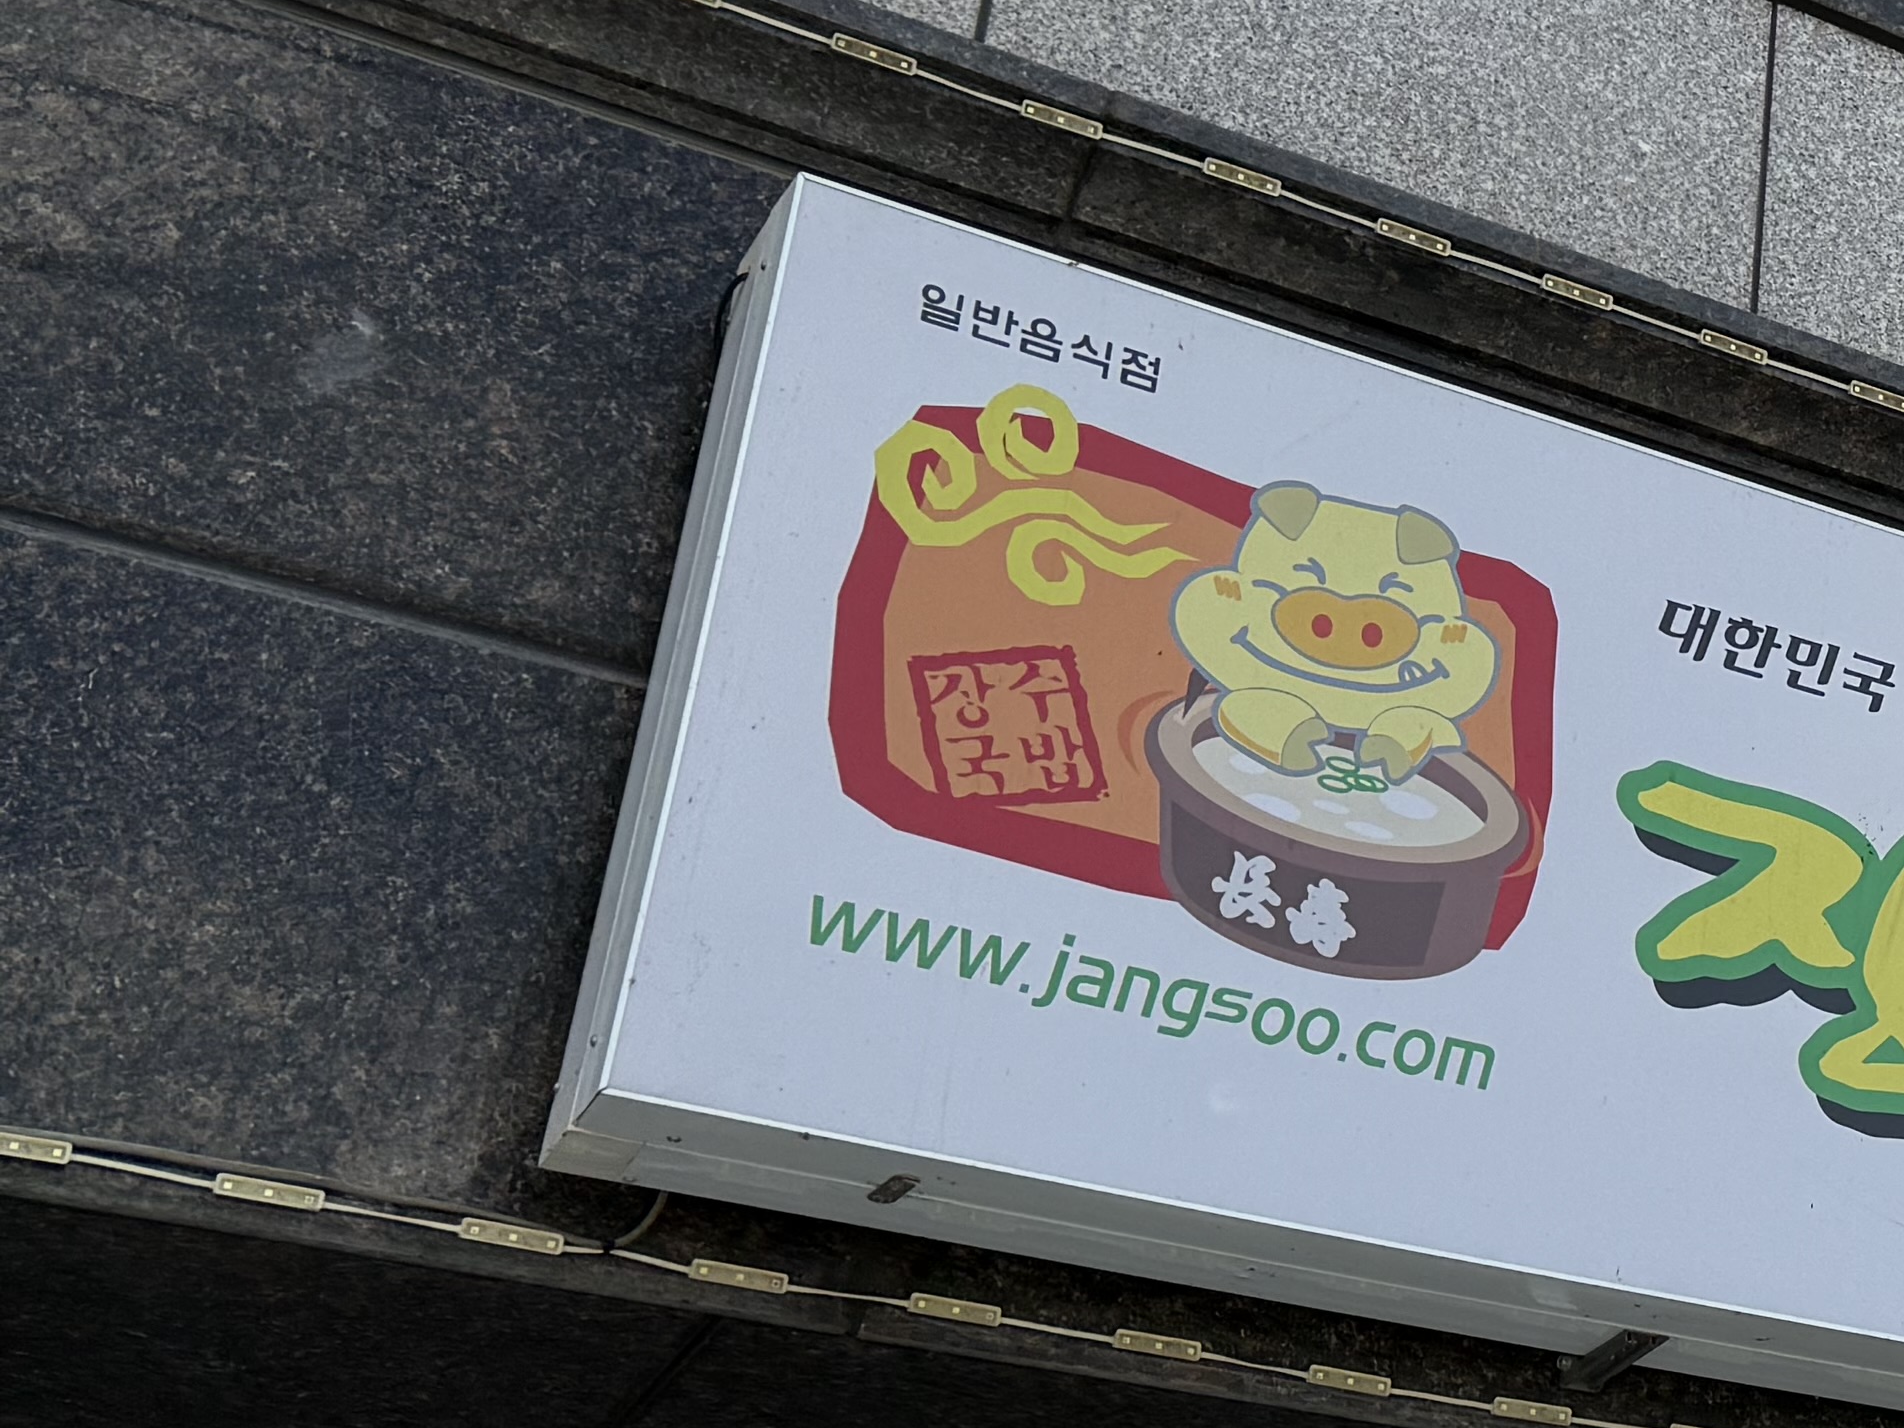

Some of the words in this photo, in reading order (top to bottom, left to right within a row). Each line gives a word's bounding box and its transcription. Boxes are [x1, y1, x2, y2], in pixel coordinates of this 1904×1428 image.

[918, 283, 1164, 394] 일반음식점
[928, 660, 1068, 730] 장수
[1657, 598, 1896, 714] 대한민국
[944, 724, 1084, 795] 국밥
[808, 894, 1497, 1090] www.jangsoo.com
